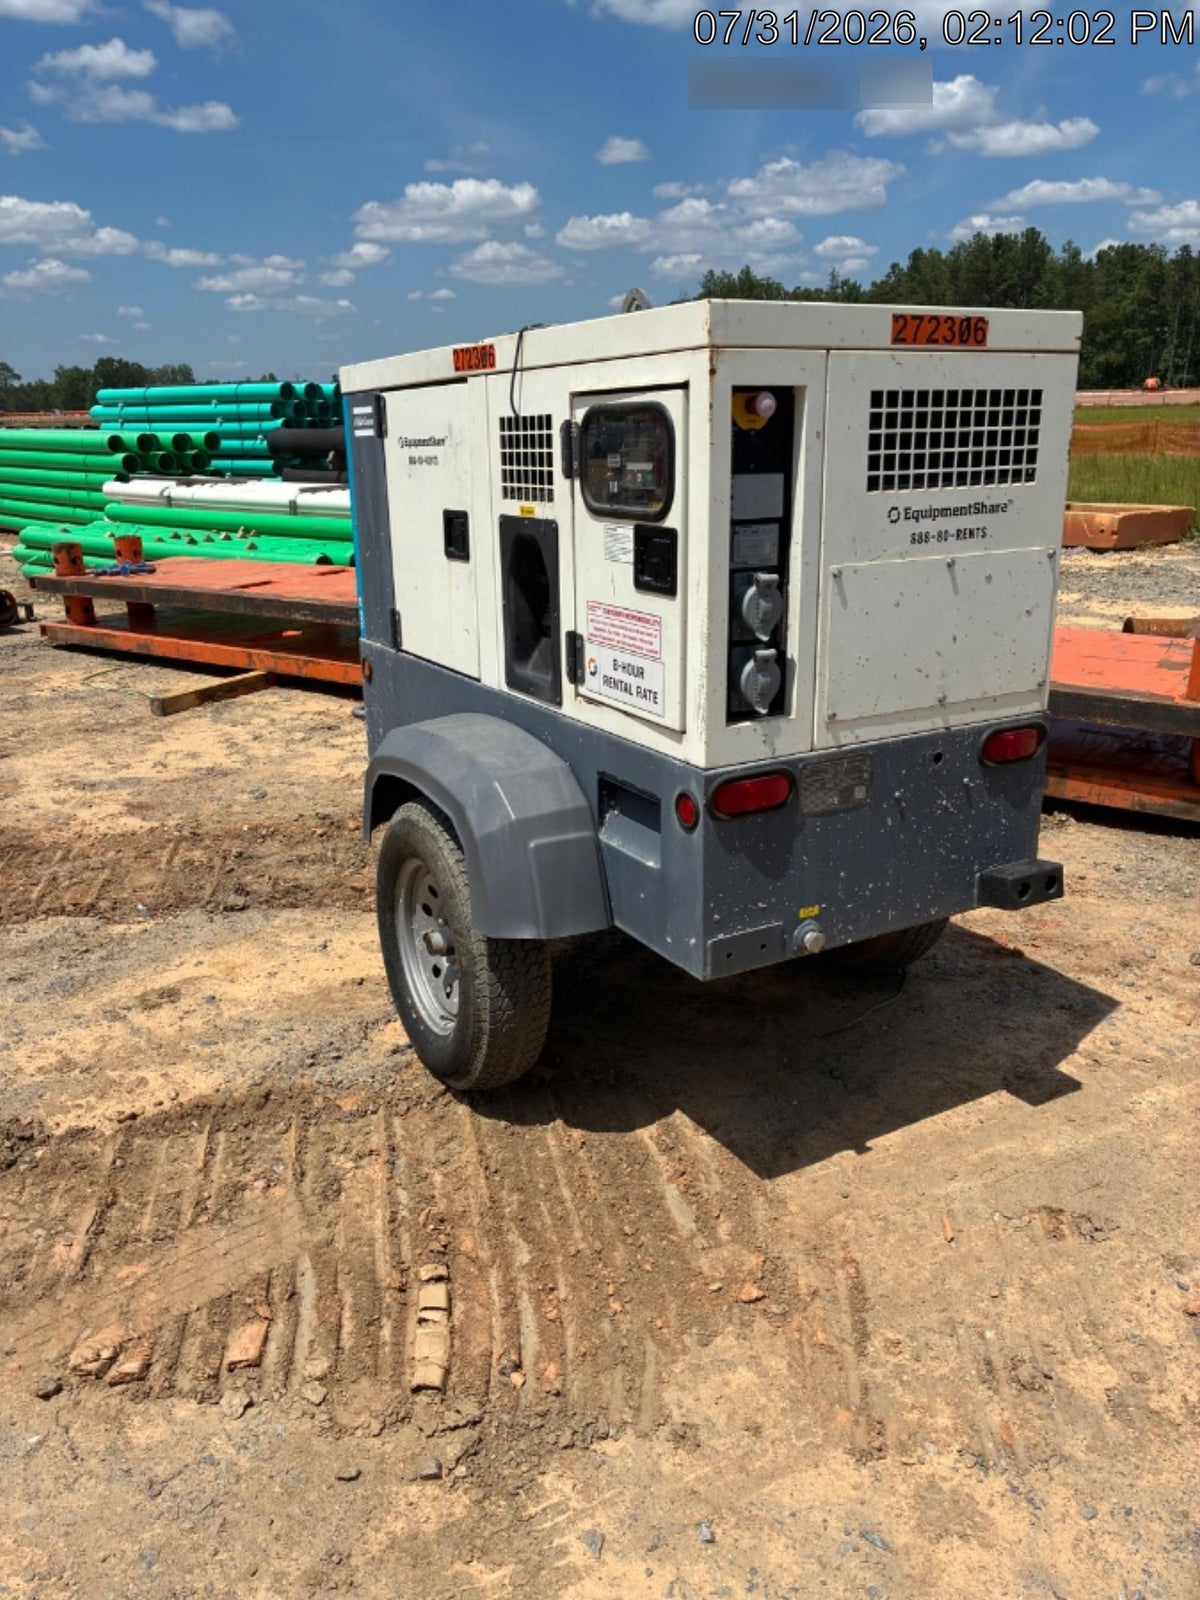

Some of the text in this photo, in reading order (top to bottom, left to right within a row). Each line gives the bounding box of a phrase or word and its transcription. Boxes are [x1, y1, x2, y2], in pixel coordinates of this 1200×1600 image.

[893, 314, 986, 344] 272306
[453, 345, 495, 371] 272306
[602, 675, 659, 705] RENTAL RATE
